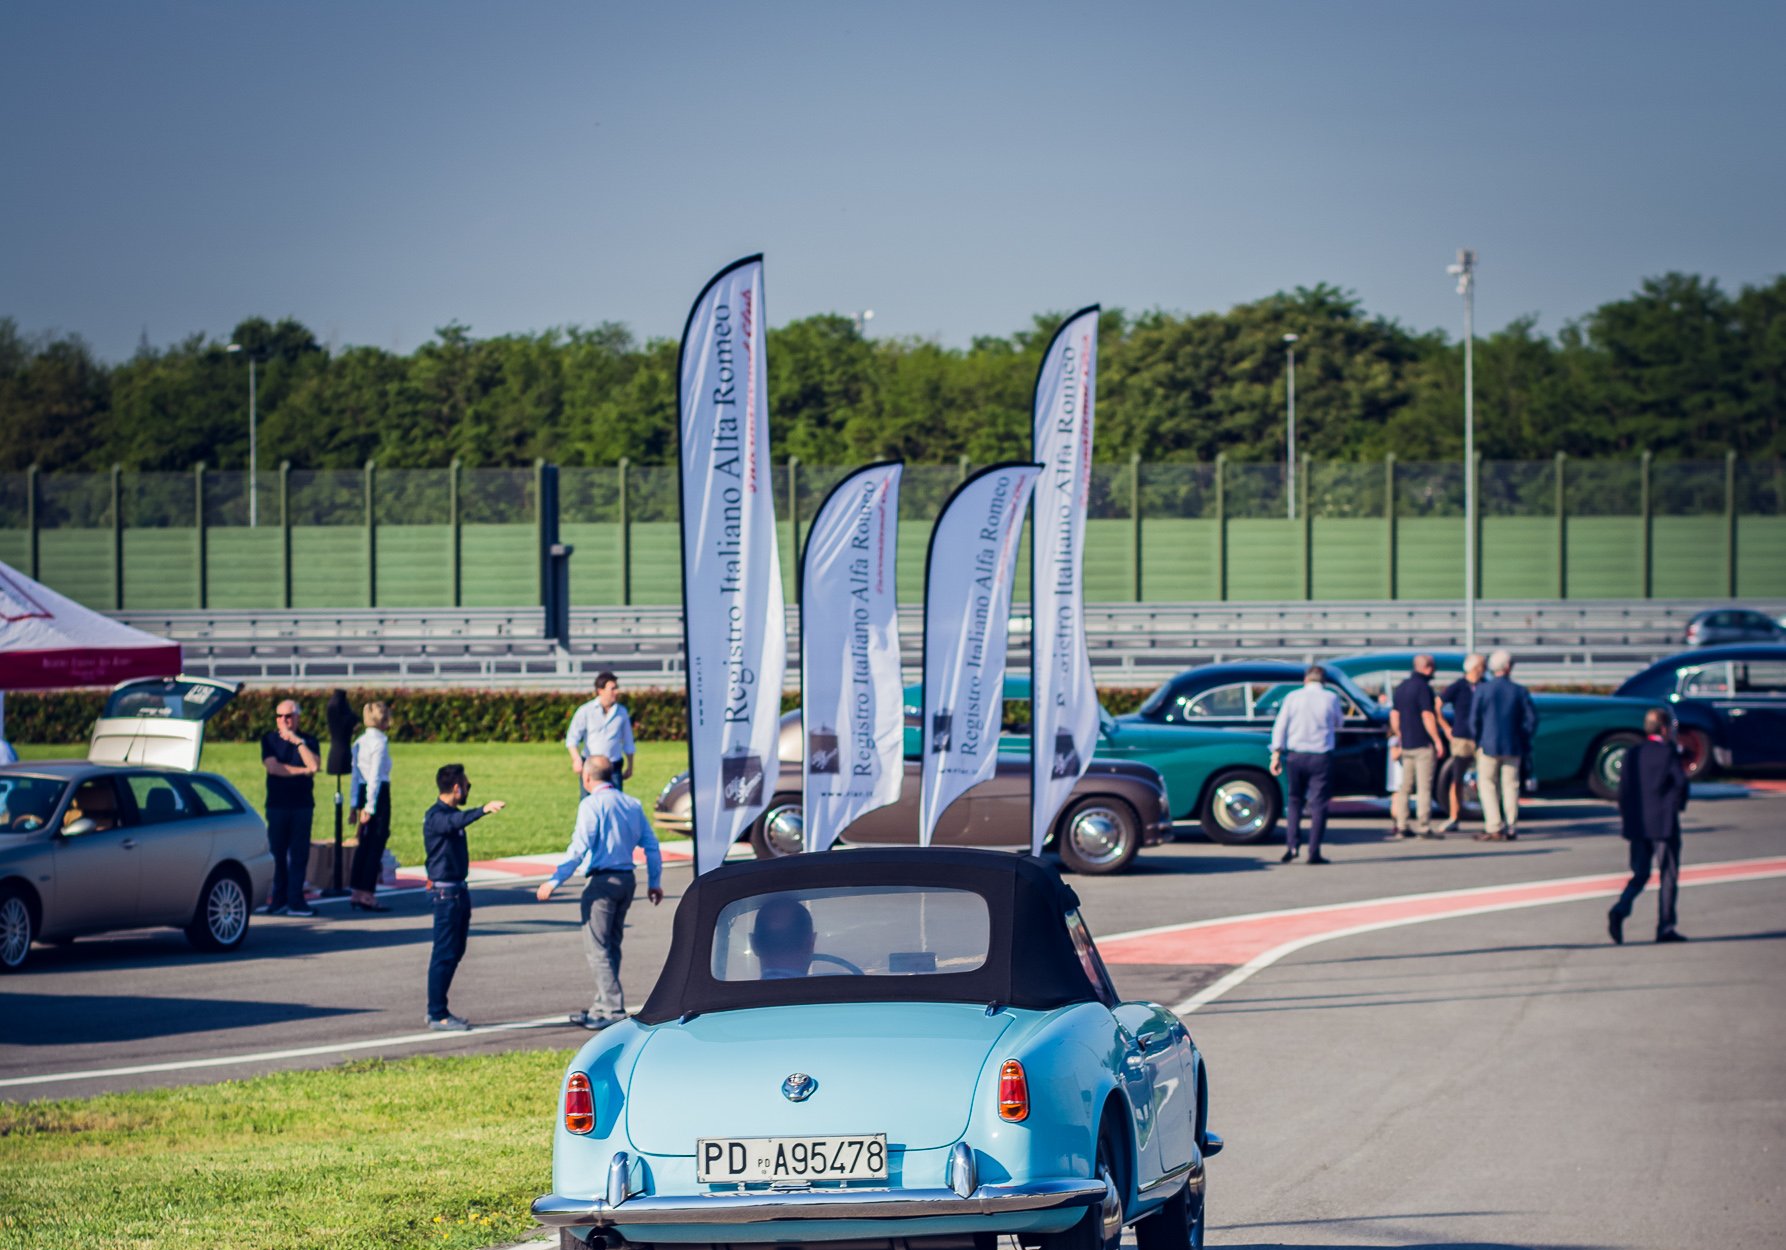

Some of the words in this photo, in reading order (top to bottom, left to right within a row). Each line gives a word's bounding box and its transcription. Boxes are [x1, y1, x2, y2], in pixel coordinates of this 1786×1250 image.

[713, 304, 736, 408] Romeo
[1057, 347, 1075, 434] Romeo
[712, 417, 740, 479] Alfa
[1056, 445, 1073, 496] Alfa
[716, 487, 741, 595] Italiano
[851, 481, 876, 551] Romeo
[979, 477, 1010, 542] Romeo
[849, 558, 869, 603] Alfa
[974, 548, 995, 590] Alfa
[1054, 505, 1073, 596] Italiano
[722, 606, 754, 725] Registro
[852, 608, 869, 685] Italiano
[966, 595, 990, 668] Italiano
[1052, 606, 1074, 707] Ristro
[852, 693, 875, 777] Registro
[960, 675, 984, 756] Registro
[705, 1142, 747, 1175] PD
[774, 1141, 884, 1175] A95478
